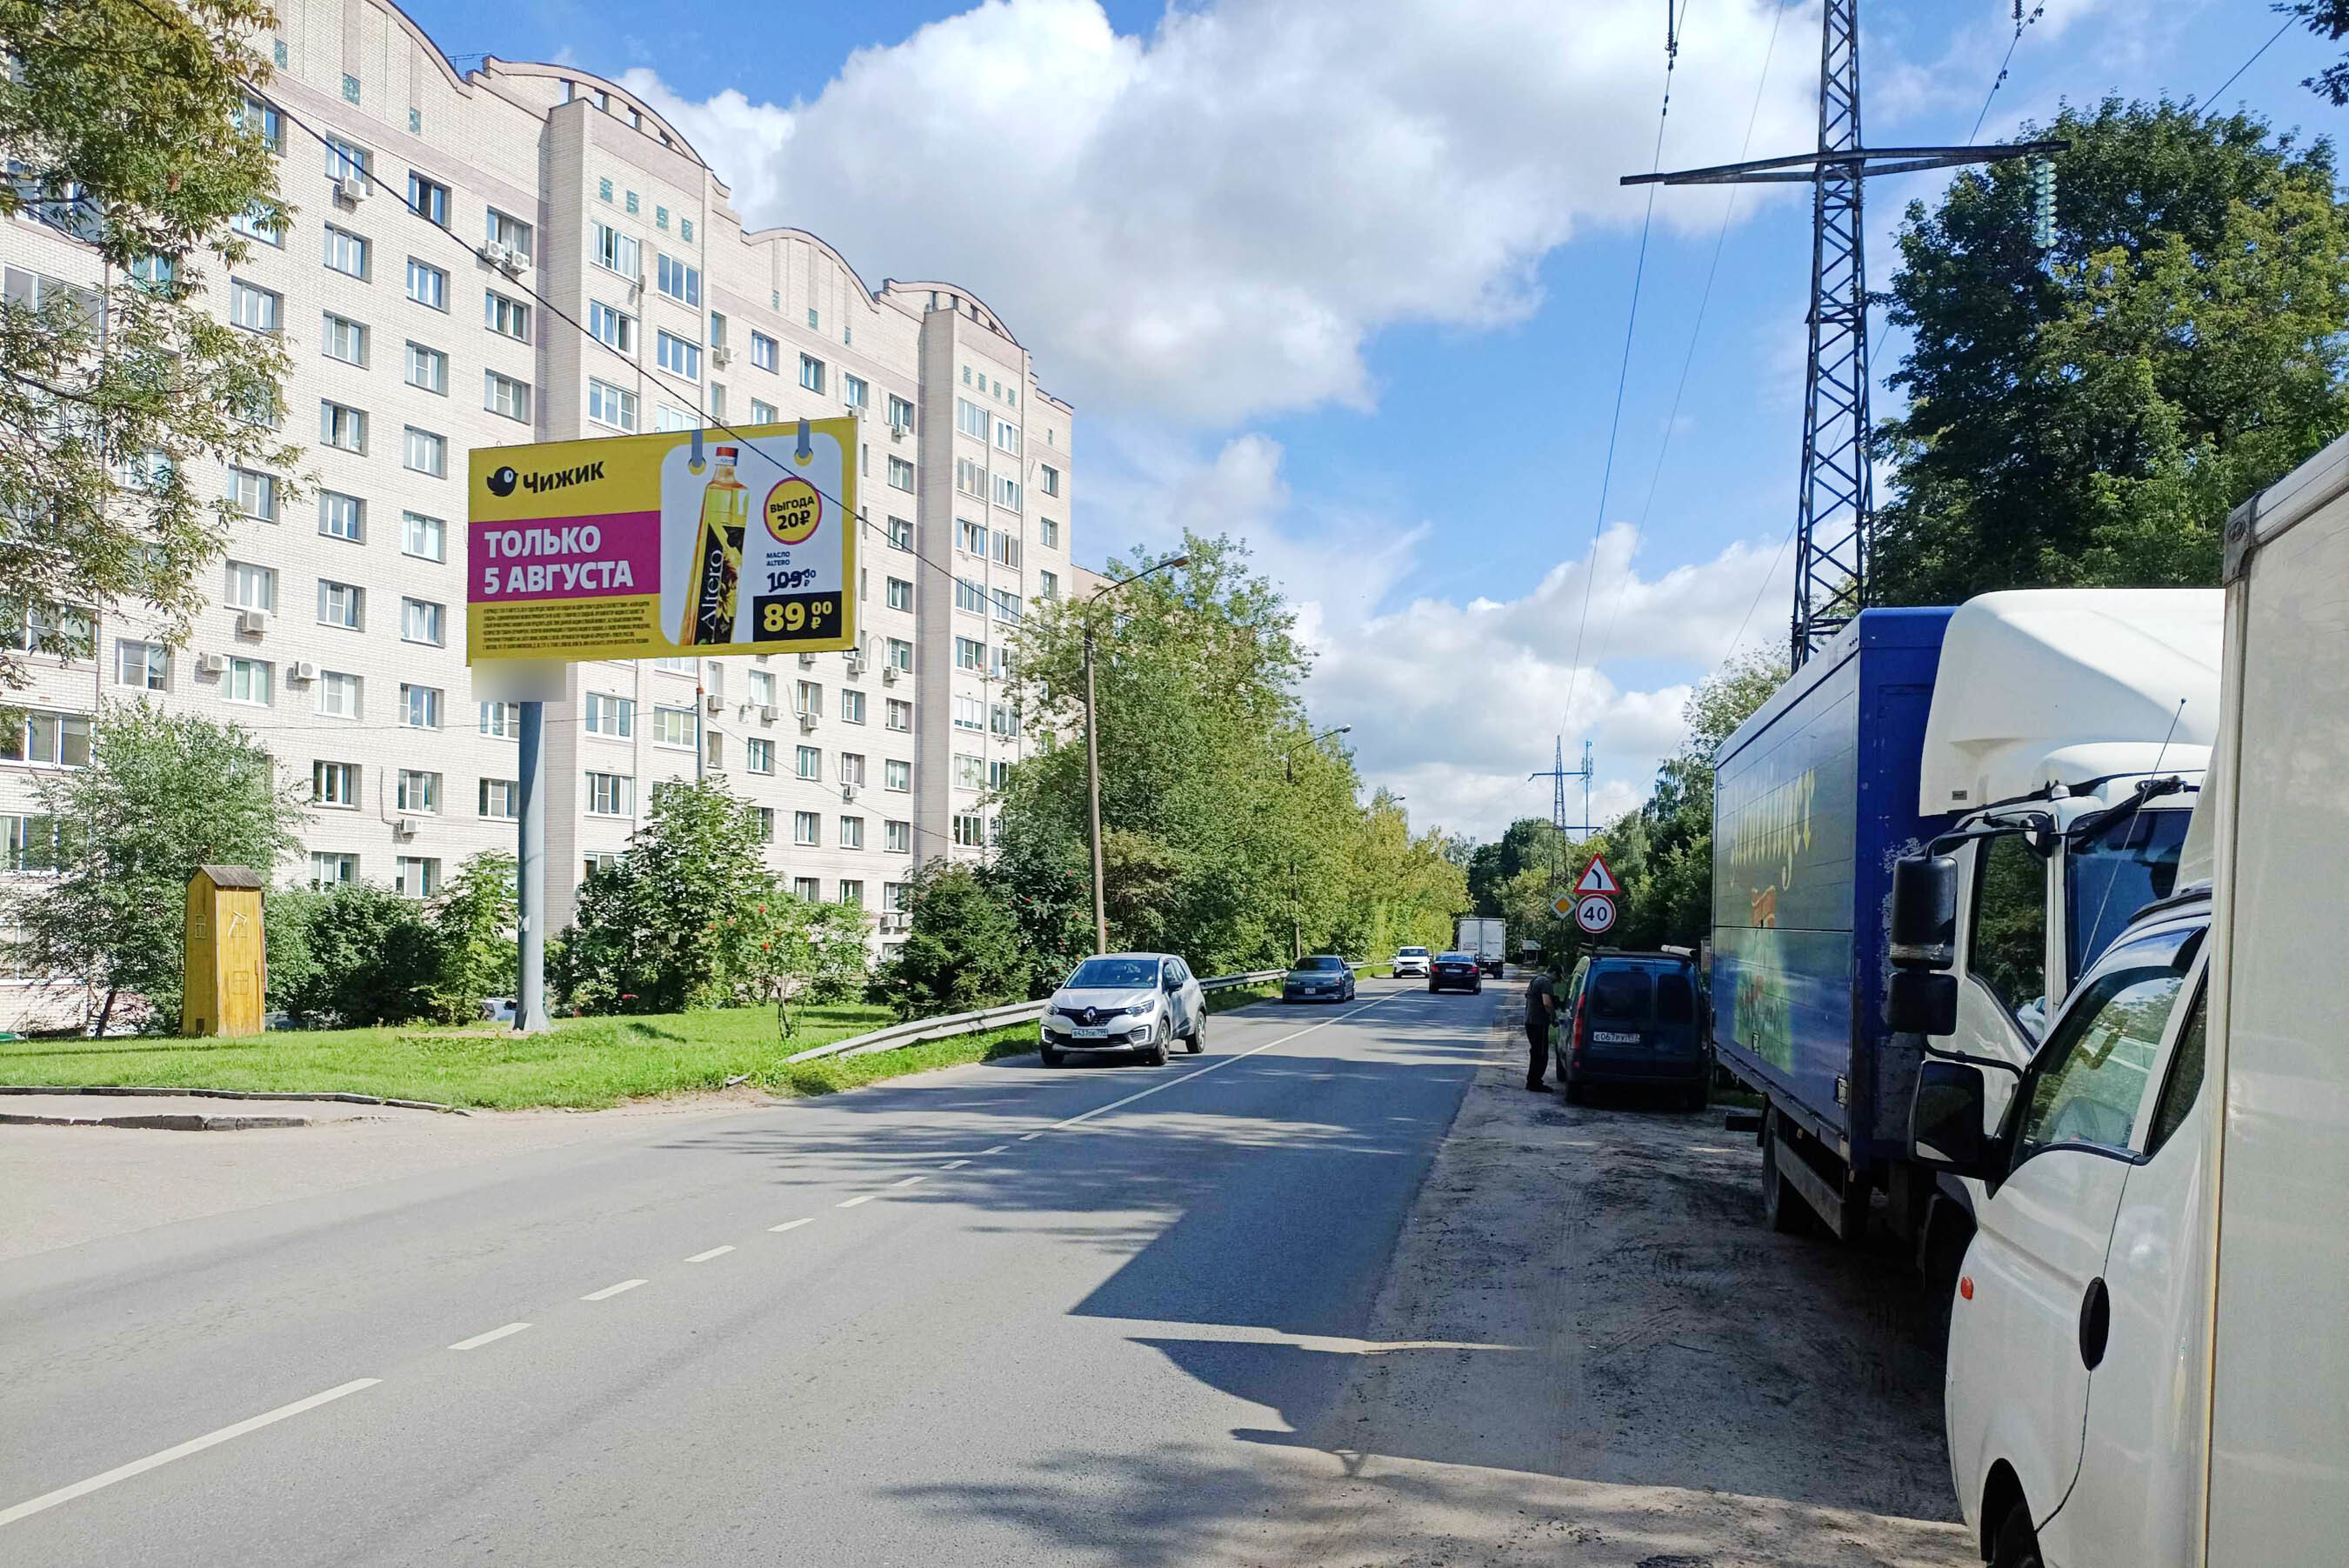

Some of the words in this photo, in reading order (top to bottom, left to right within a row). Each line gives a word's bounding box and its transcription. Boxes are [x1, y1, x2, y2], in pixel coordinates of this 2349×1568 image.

[523, 460, 604, 494] Чижик
[770, 496, 815, 513] ВЫГОДА
[484, 525, 601, 558] ТОЛЬКО
[484, 567, 500, 595] 5
[505, 560, 634, 593] АВГУСТА
[701, 550, 724, 644] Altero
[1584, 906, 1607, 922] 40
